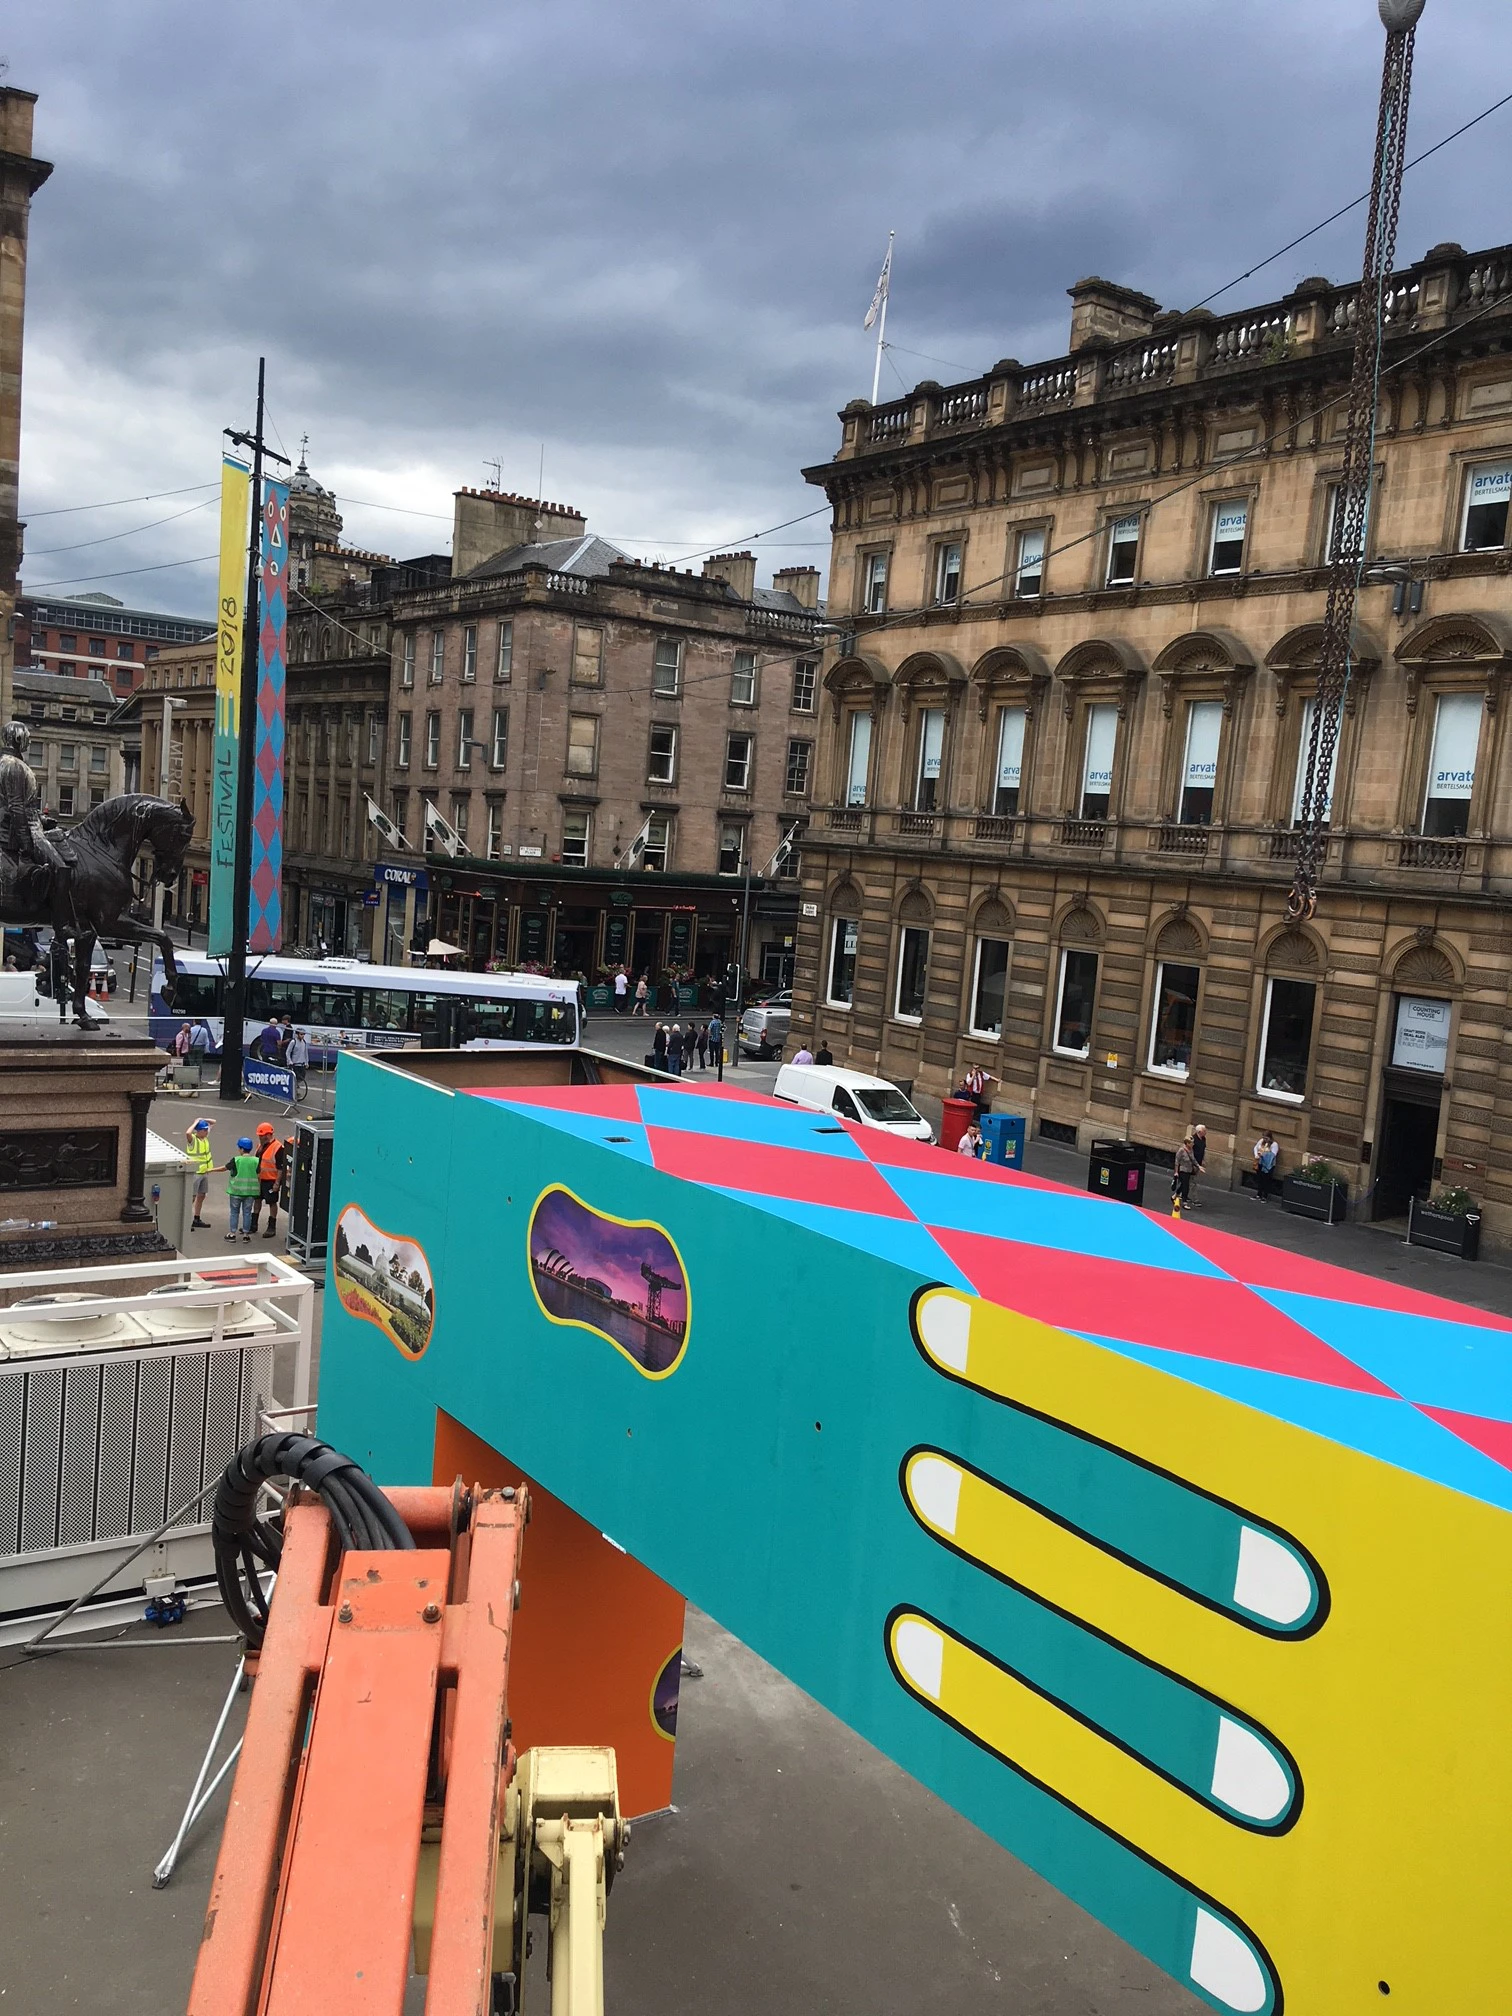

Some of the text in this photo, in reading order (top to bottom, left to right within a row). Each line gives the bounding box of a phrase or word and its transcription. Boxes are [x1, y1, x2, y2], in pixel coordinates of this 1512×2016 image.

[1220, 513, 1247, 527] arvat
[220, 597, 237, 676] 2018
[1190, 762, 1216, 773] arvat
[217, 749, 234, 869] FESTIVAL
[384, 868, 412, 884] CORAL
[1412, 1006, 1441, 1015] COUNTING
[247, 1072, 290, 1086] STORE OPEN
[1292, 1179, 1322, 1190] wetherspoon
[1420, 1209, 1454, 1222] wetherspoon
